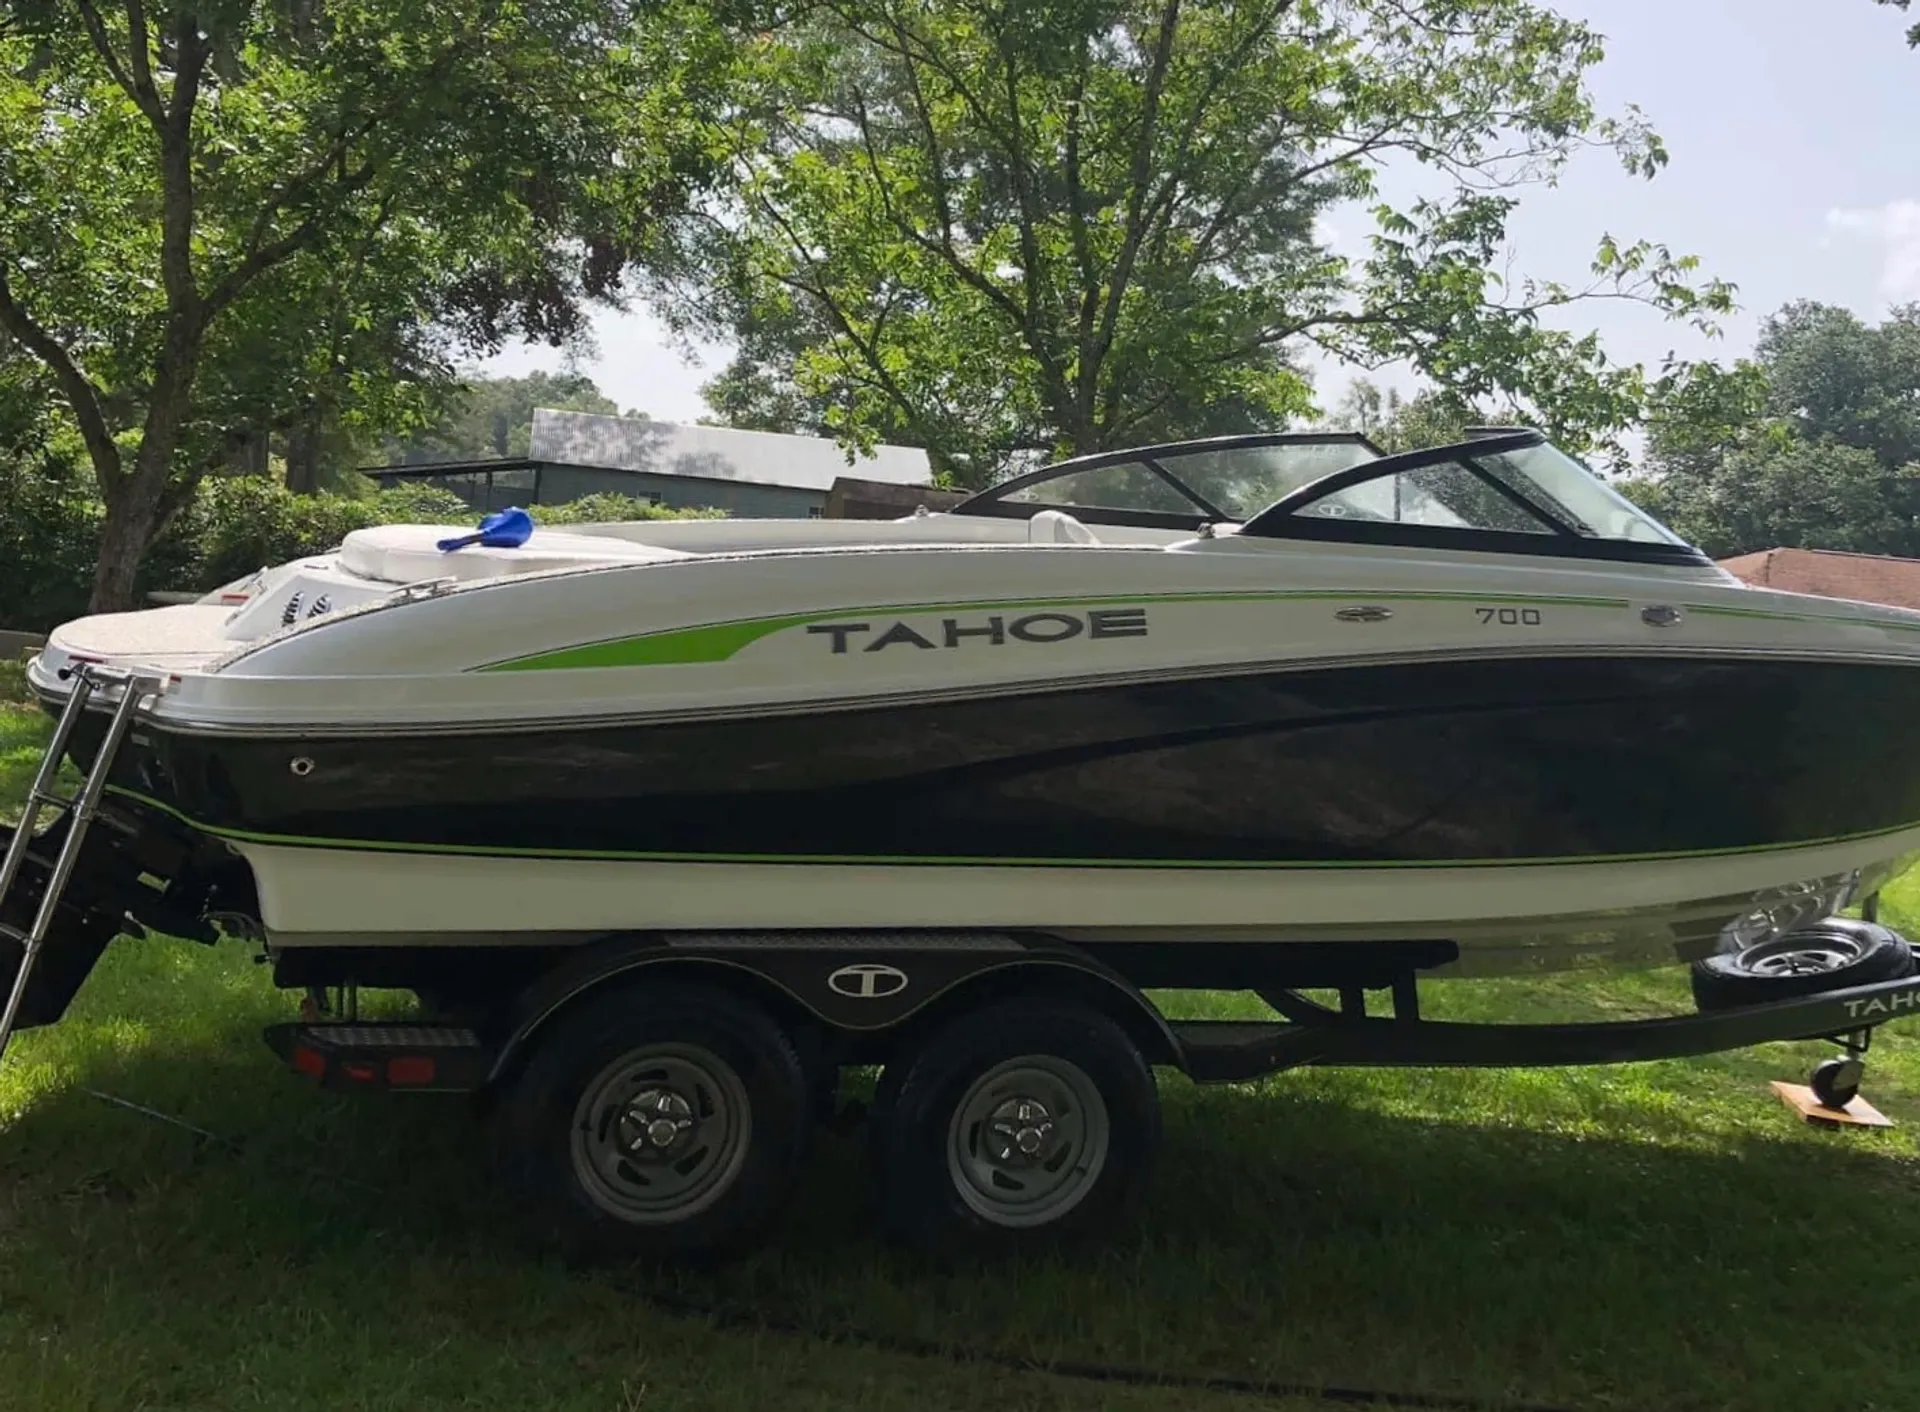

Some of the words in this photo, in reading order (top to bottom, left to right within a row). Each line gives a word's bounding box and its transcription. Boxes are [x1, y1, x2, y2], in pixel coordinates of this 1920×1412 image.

[1475, 607, 1541, 626] 700
[806, 608, 1148, 654] TAHOE
[1843, 990, 1920, 1018] TAH
